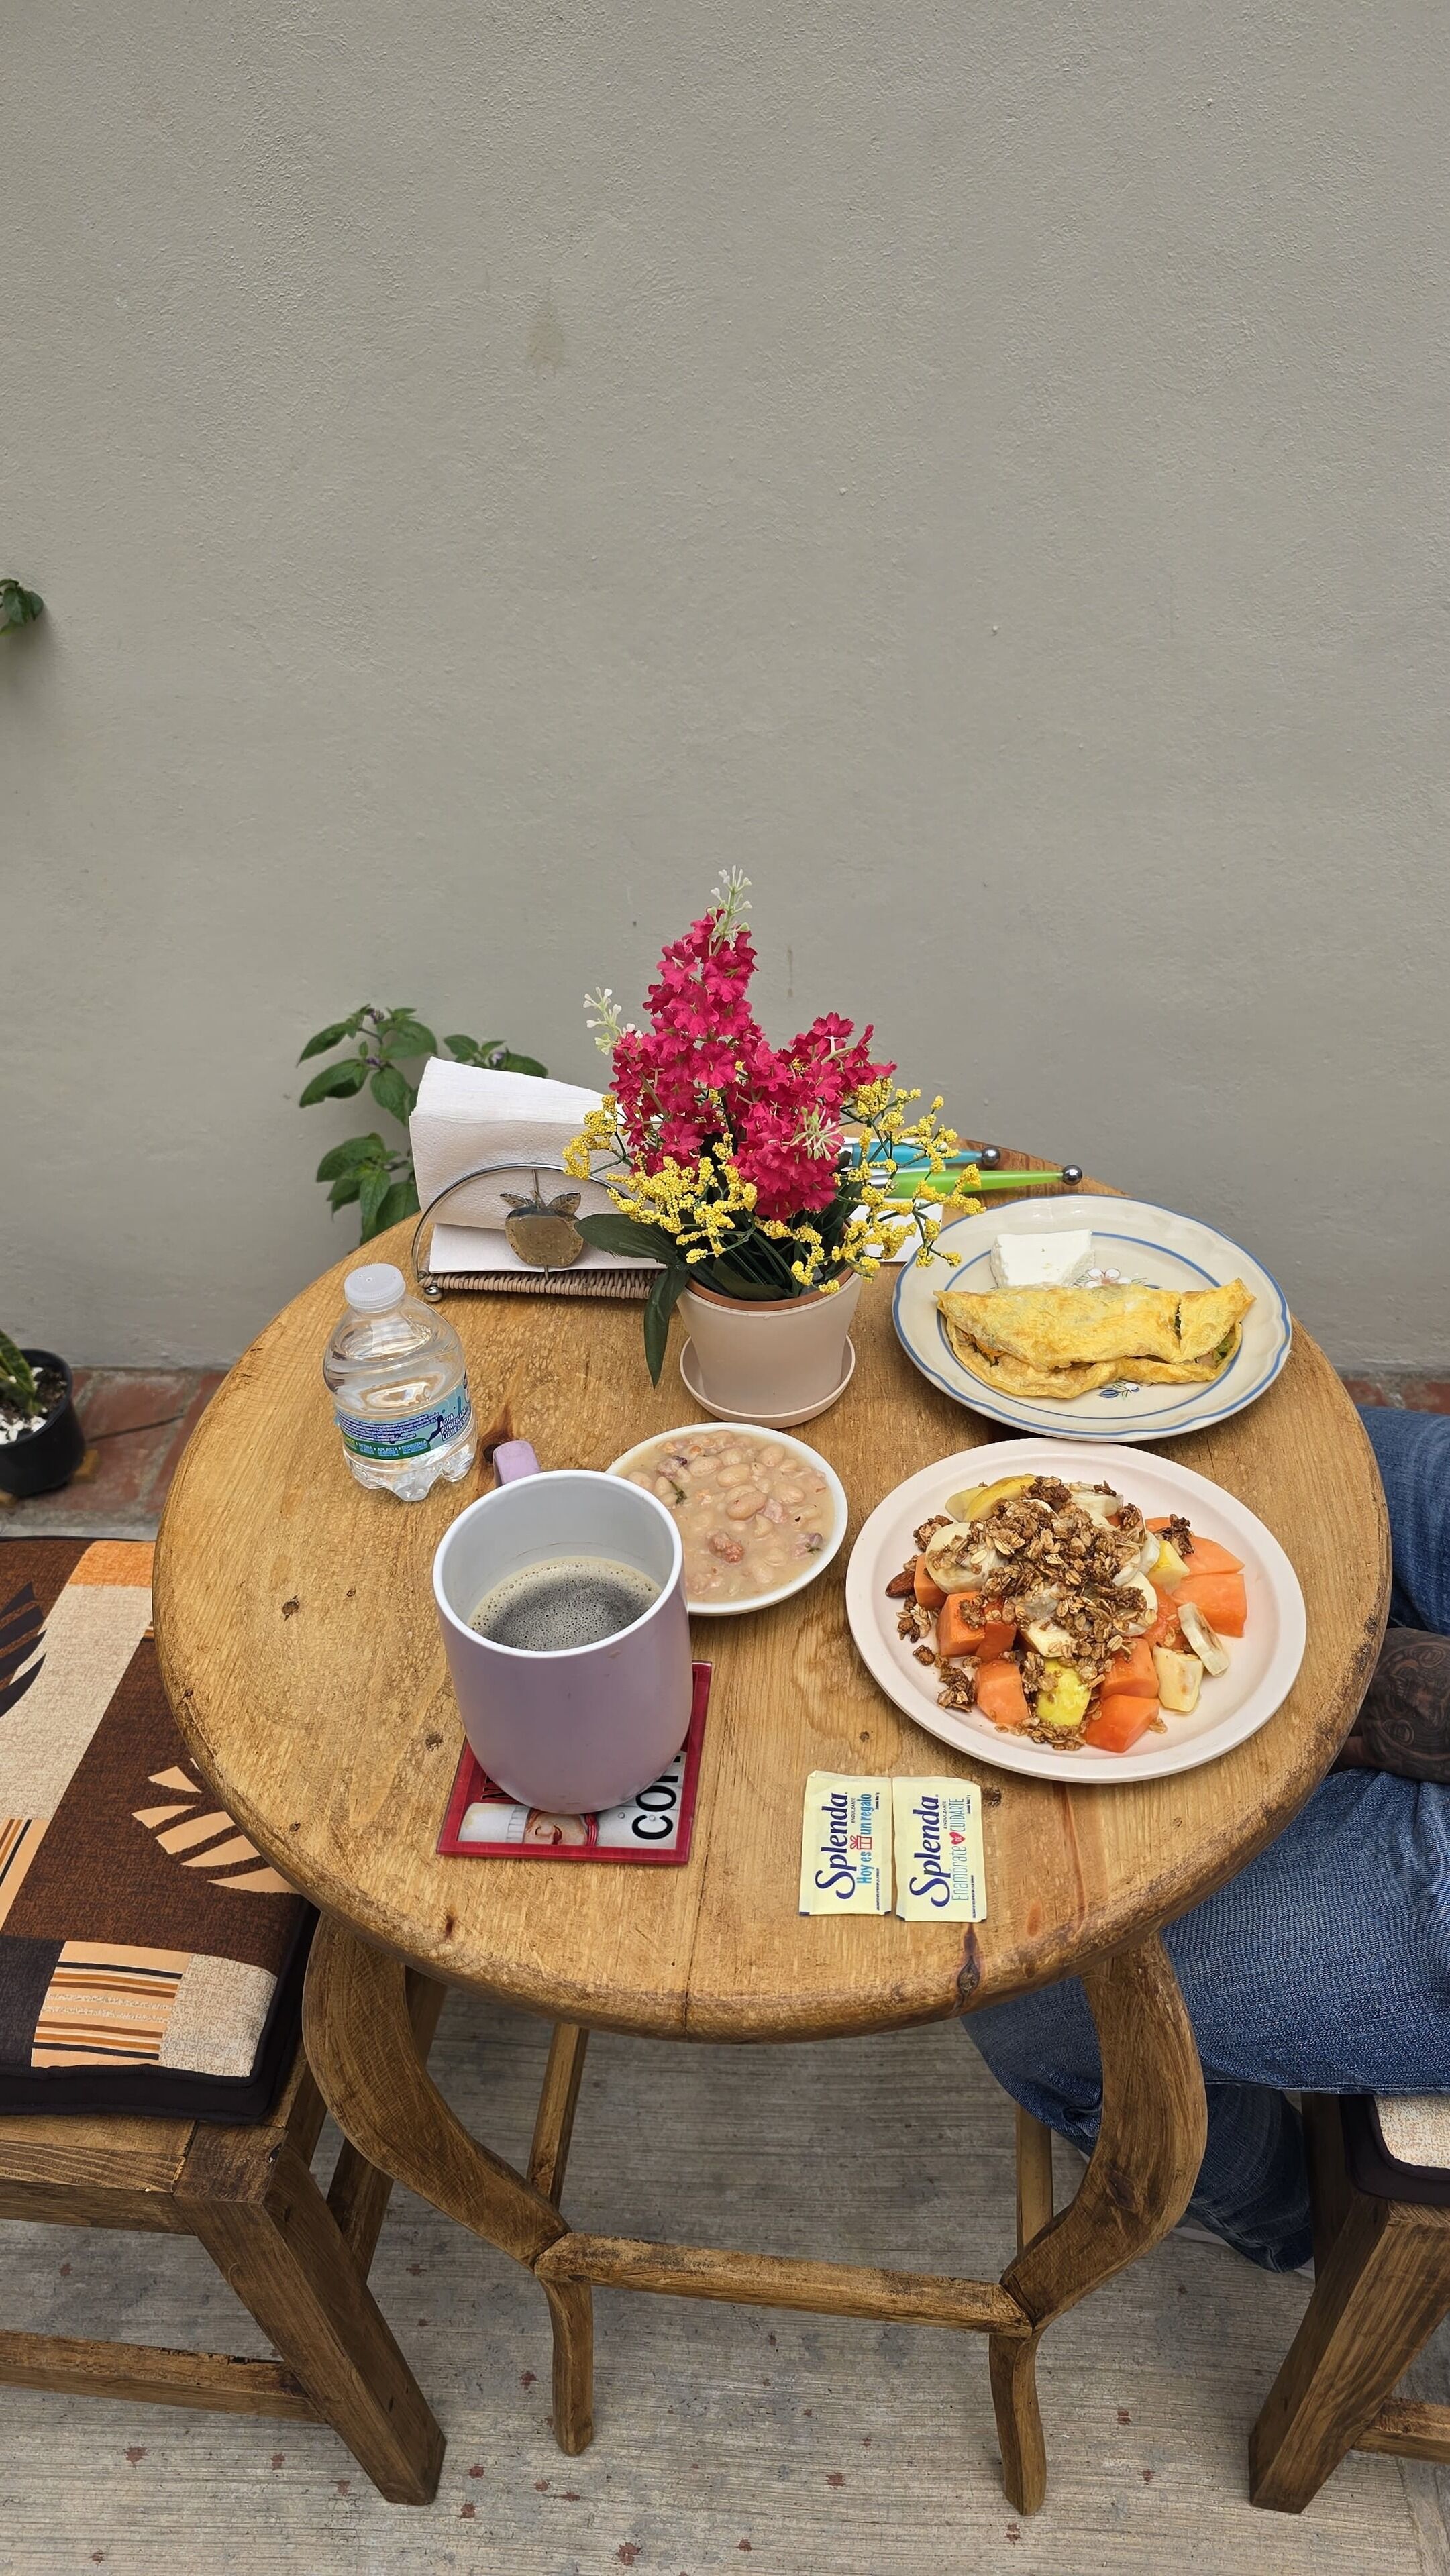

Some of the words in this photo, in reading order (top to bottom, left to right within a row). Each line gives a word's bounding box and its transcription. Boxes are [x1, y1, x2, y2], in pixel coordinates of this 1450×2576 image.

[439, 1413, 454, 1428] AGUA
[442, 1427, 458, 1441] LIBRE
[857, 1794, 874, 1821] regalo
[949, 1798, 966, 1832] CUIDARTE
[860, 1823, 872, 1835] un
[815, 1792, 857, 1900] Splenda
[861, 1851, 872, 1862] es
[909, 1795, 951, 1907] Splenda
[856, 1864, 874, 1884] Hoy
[949, 1845, 969, 1901] Enamórate
